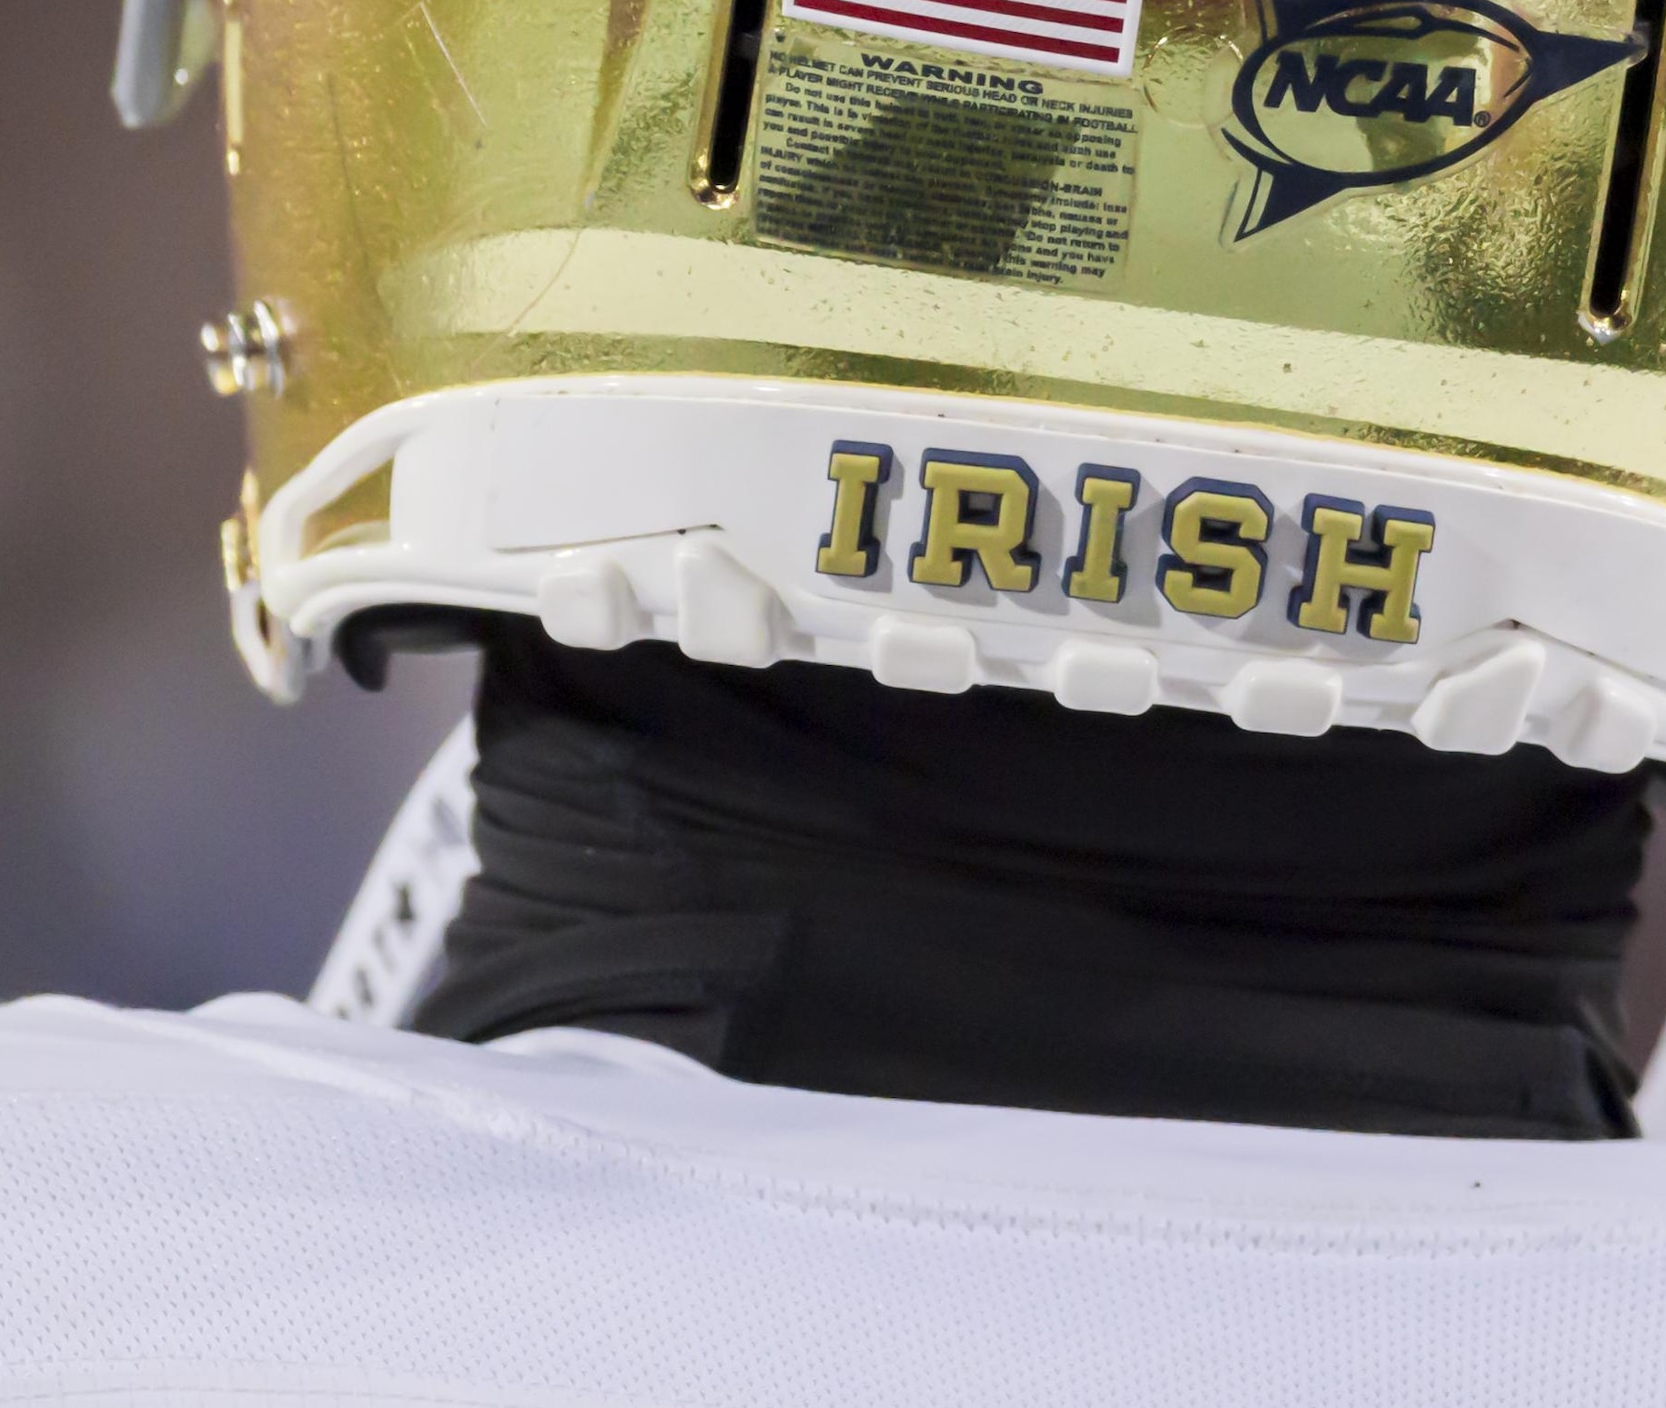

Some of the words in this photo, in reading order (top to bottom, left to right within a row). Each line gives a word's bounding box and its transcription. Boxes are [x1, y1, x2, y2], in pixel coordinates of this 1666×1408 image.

[788, 55, 836, 72] HELMET
[839, 64, 863, 78] CAN
[867, 70, 921, 89] PREVENT
[927, 80, 980, 97] SERIOUS
[983, 90, 1016, 103] HEAD
[1020, 95, 1039, 107] OR
[1042, 98, 1076, 111] NECK
[1079, 103, 1133, 119] INJURIES
[860, 52, 1044, 95] WARNING
[778, 66, 823, 84] PLAYER
[826, 76, 863, 92] MIGHT
[963, 101, 1053, 124] PARTICIPATING
[1056, 114, 1070, 125] IN
[1073, 117, 1138, 133] FOOTBALL
[806, 100, 830, 115] This
[785, 82, 801, 94] Do
[804, 88, 822, 99] not
[849, 95, 871, 108] this
[1065, 131, 1122, 148] opposing
[1069, 159, 1083, 169] or
[1060, 223, 1104, 239] playing
[1030, 259, 1077, 275] warning
[1035, 247, 1059, 258] and
[815, 439, 1435, 645] IRISH
